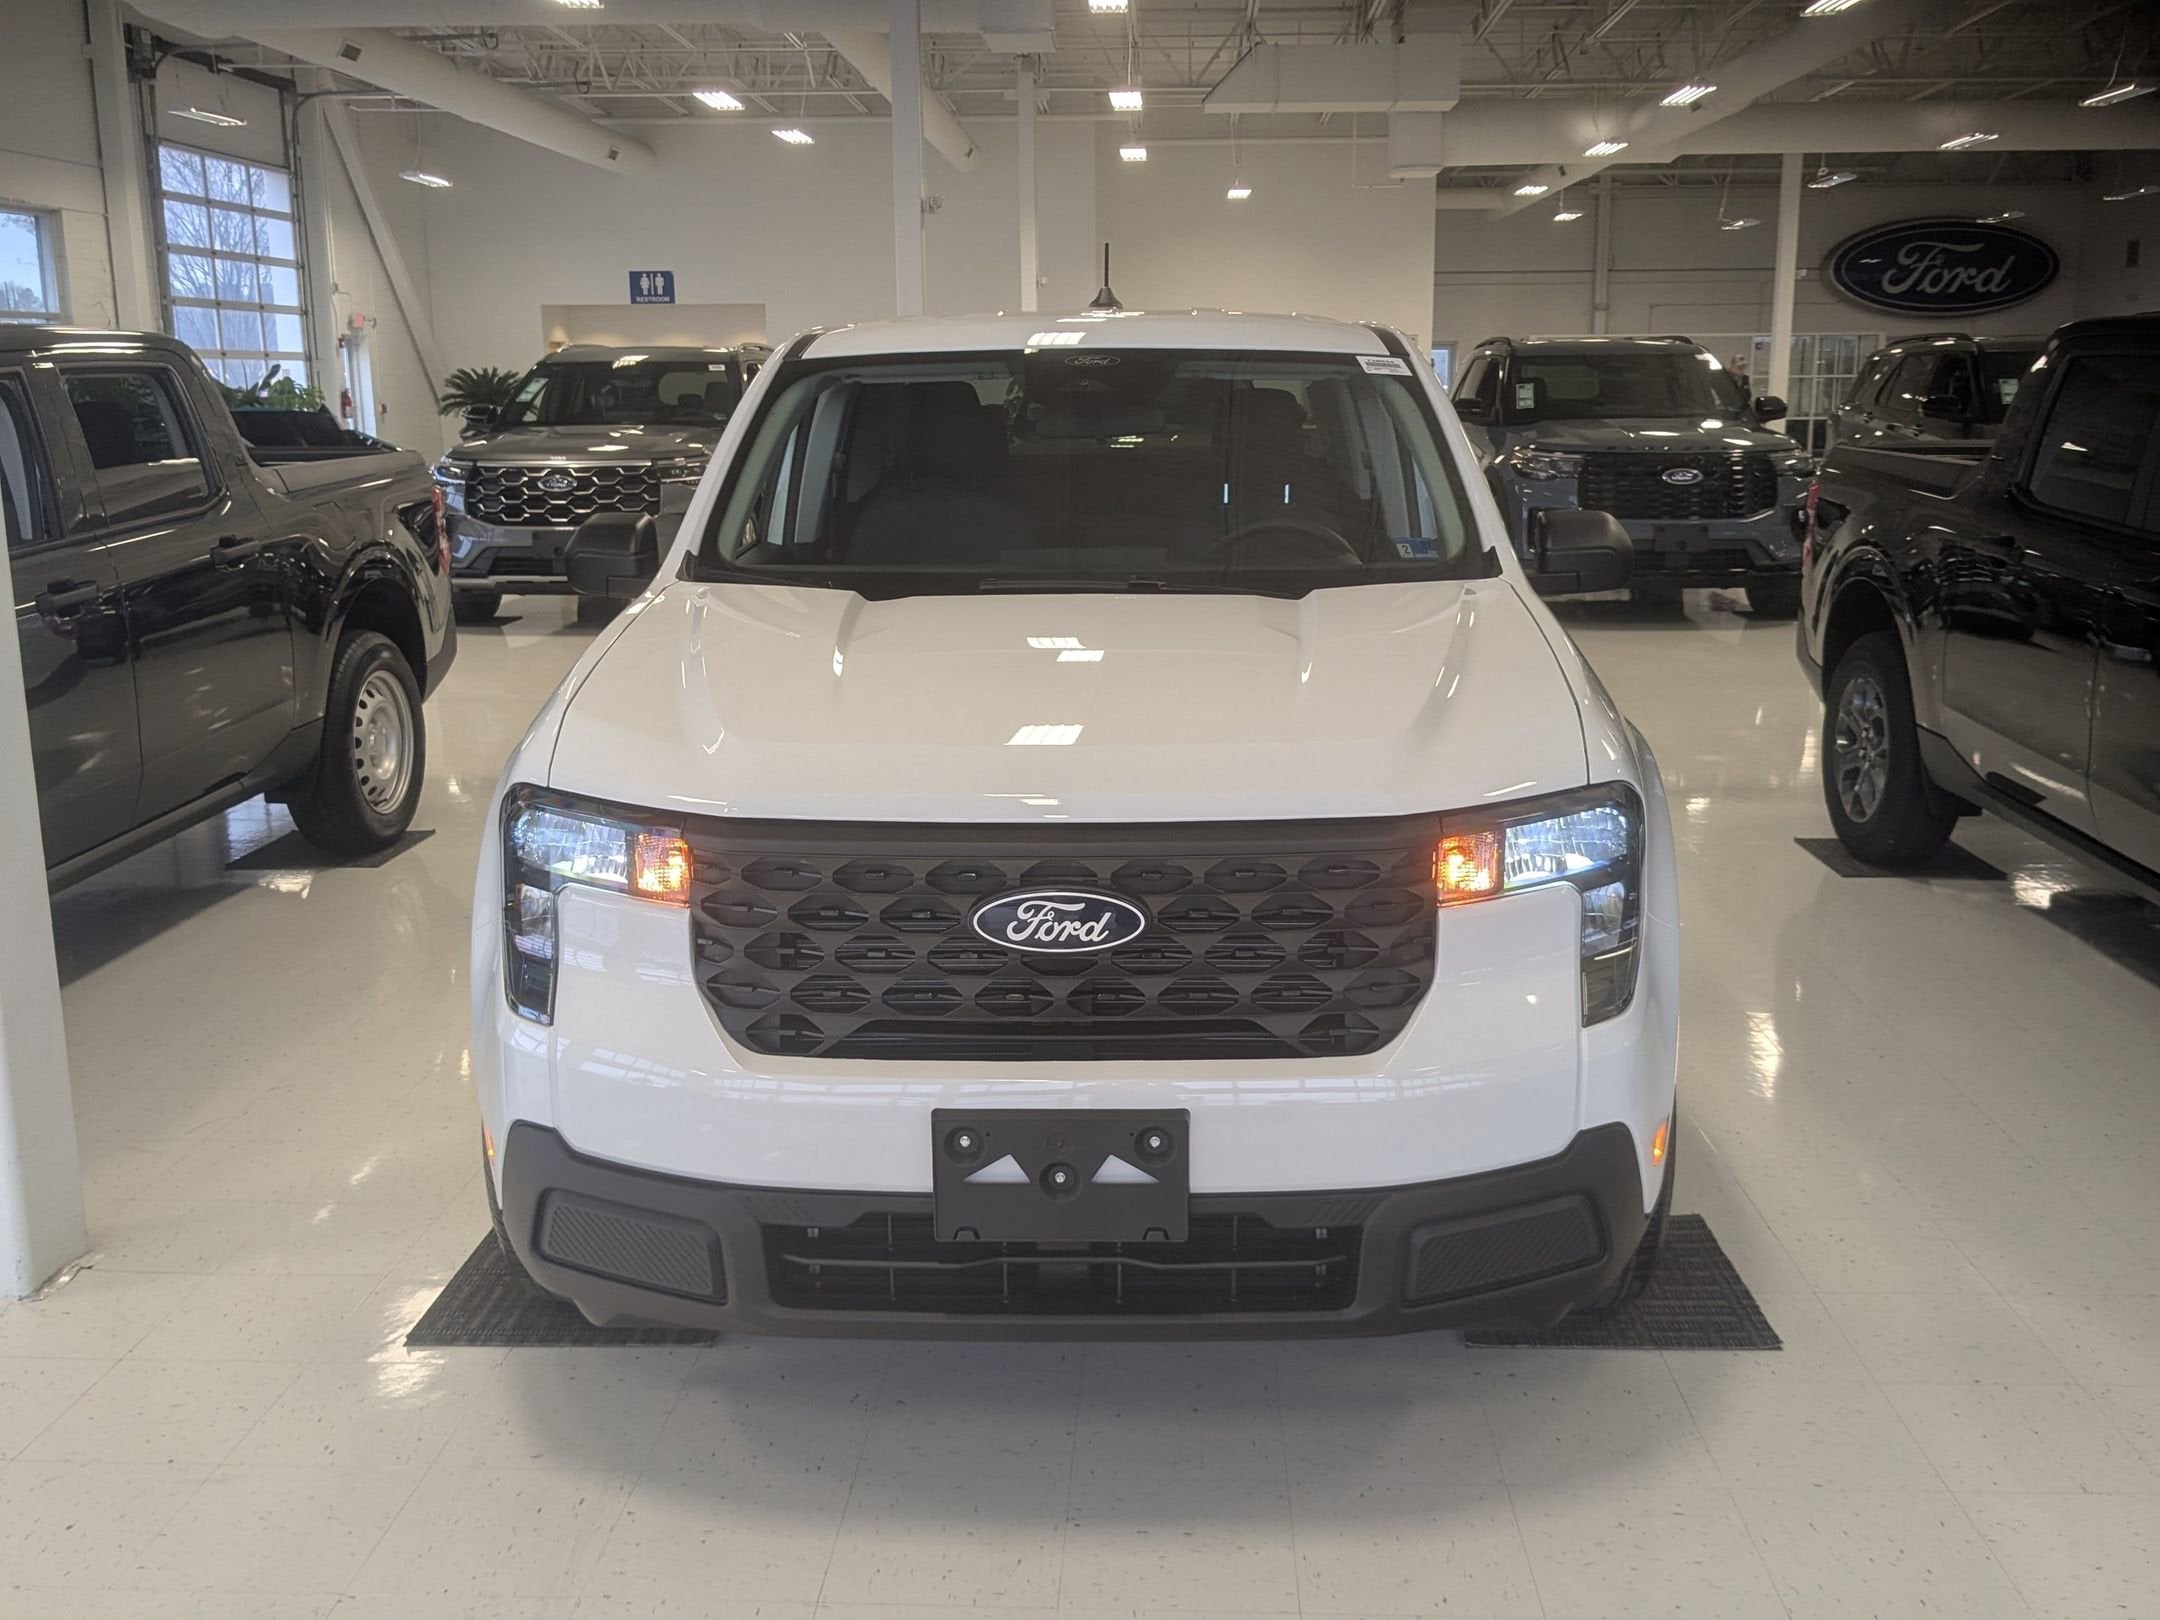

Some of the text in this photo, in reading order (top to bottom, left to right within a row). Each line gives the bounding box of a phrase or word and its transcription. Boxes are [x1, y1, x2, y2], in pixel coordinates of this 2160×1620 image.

[1881, 241, 2016, 294] Ford
[1074, 356, 1111, 365] Ford
[1401, 544, 1411, 555] 2
[1006, 900, 1112, 942] Ford
